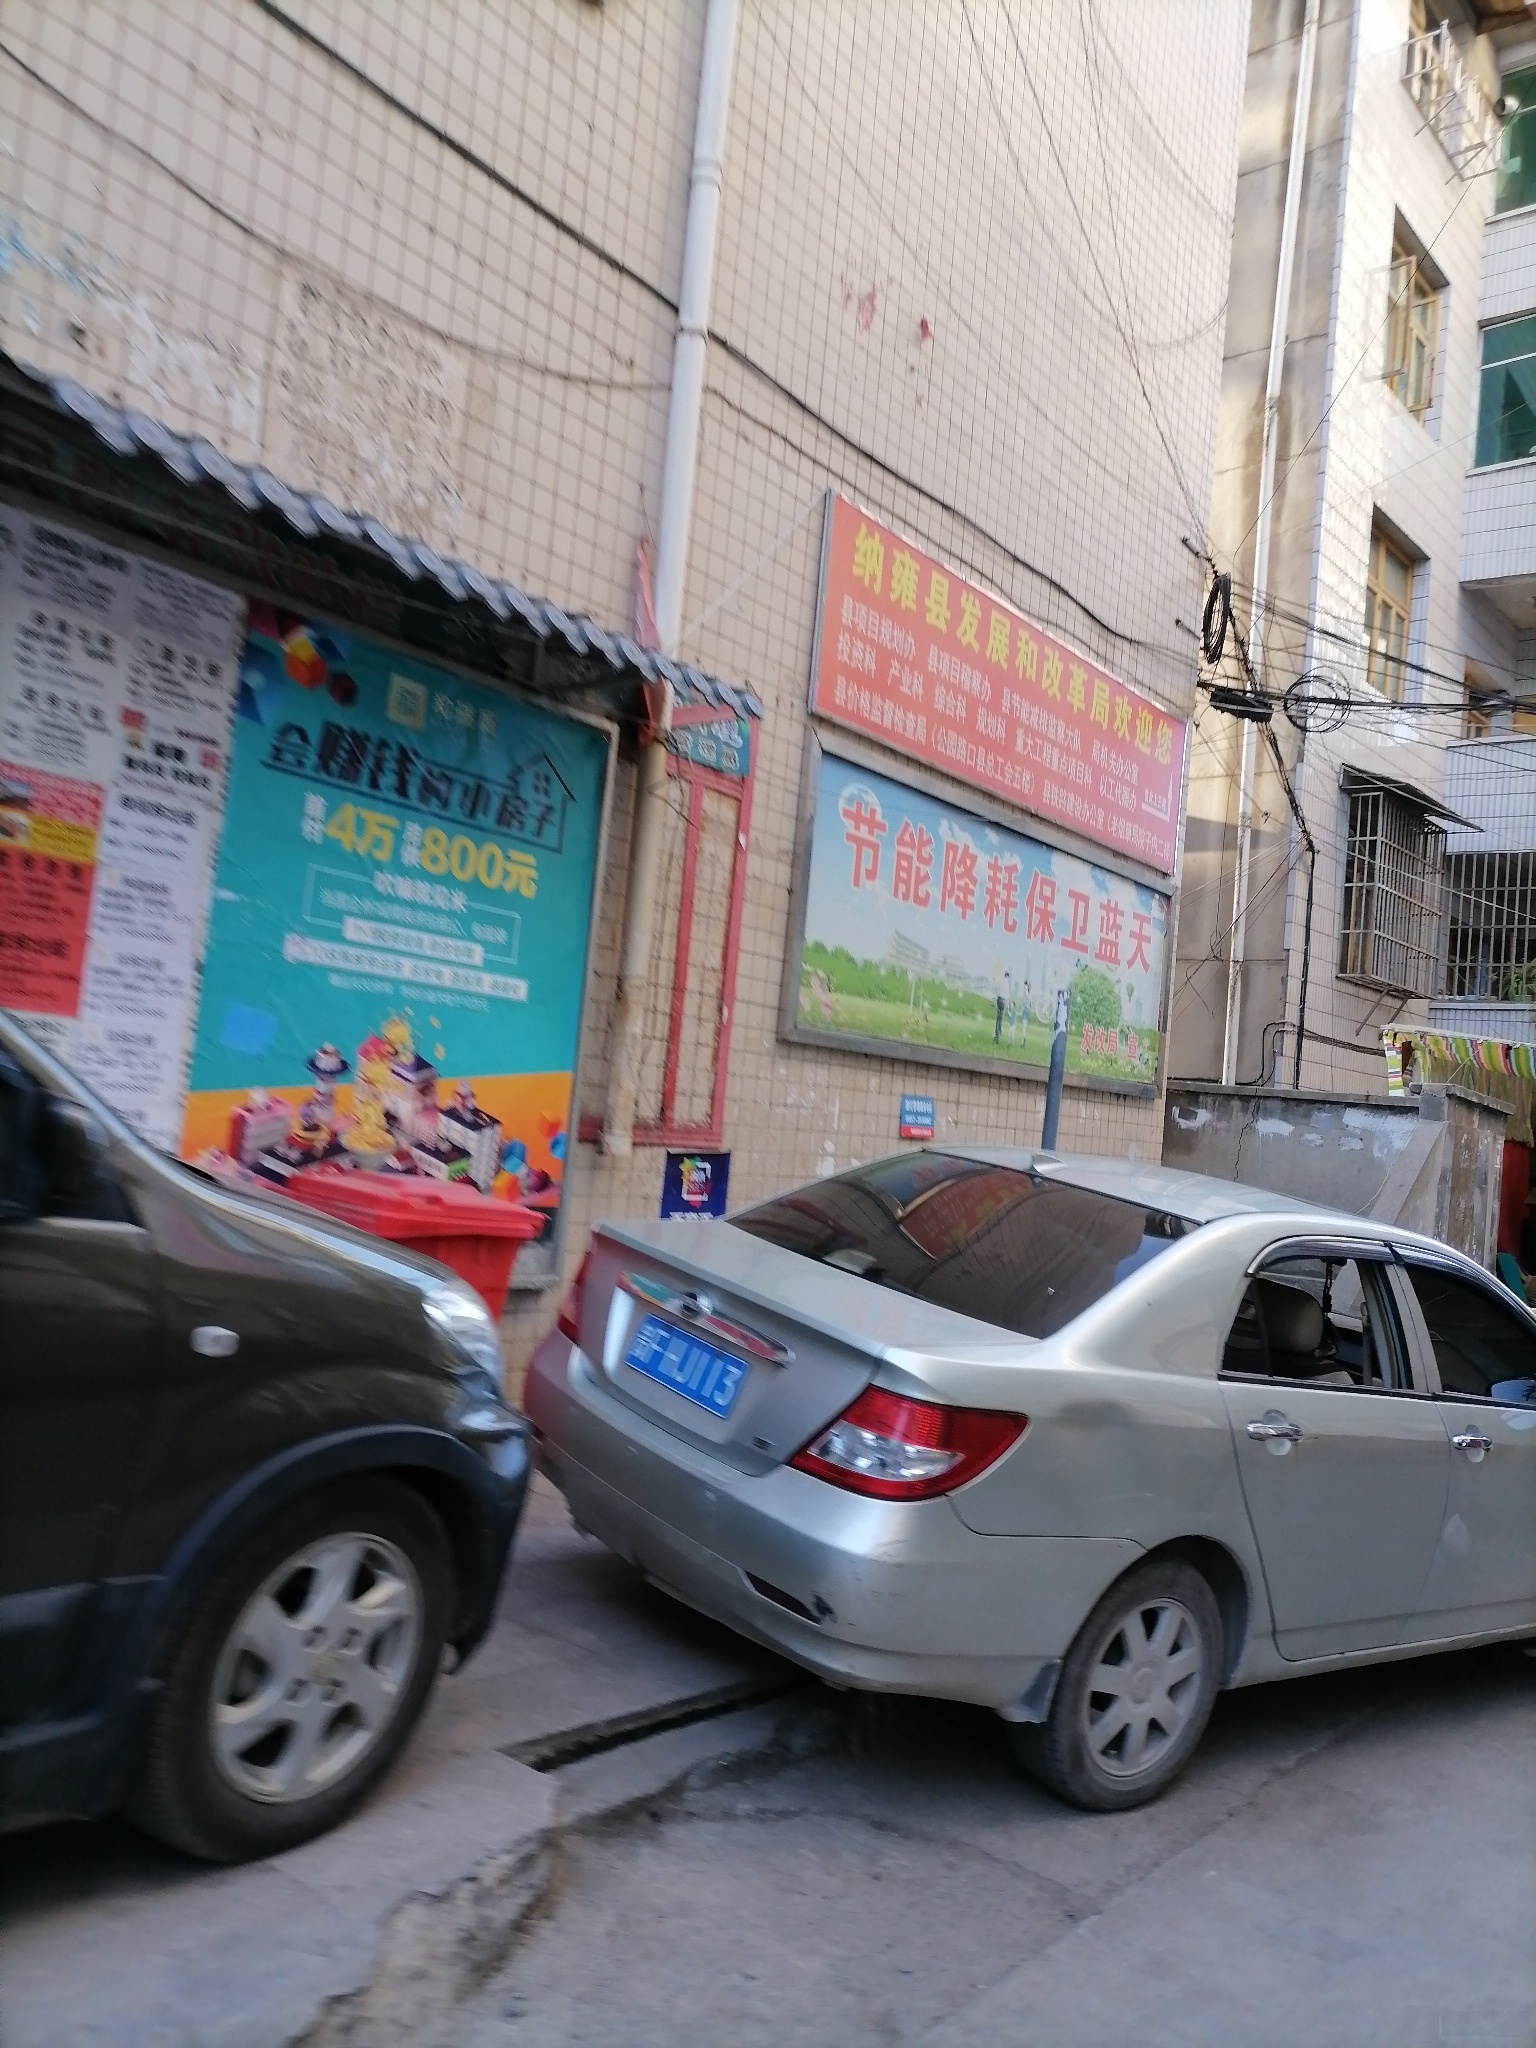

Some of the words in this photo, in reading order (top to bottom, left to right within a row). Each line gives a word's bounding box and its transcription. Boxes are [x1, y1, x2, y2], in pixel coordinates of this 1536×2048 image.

[851, 519, 1174, 767] 纳雍县发展和改革局欢迎您
[887, 655, 924, 703] 产业科
[1091, 738, 1139, 785] 局机关办公室
[842, 800, 1153, 974] 节能降耗保卫蓝天
[1081, 1022, 1118, 1055] 发改局
